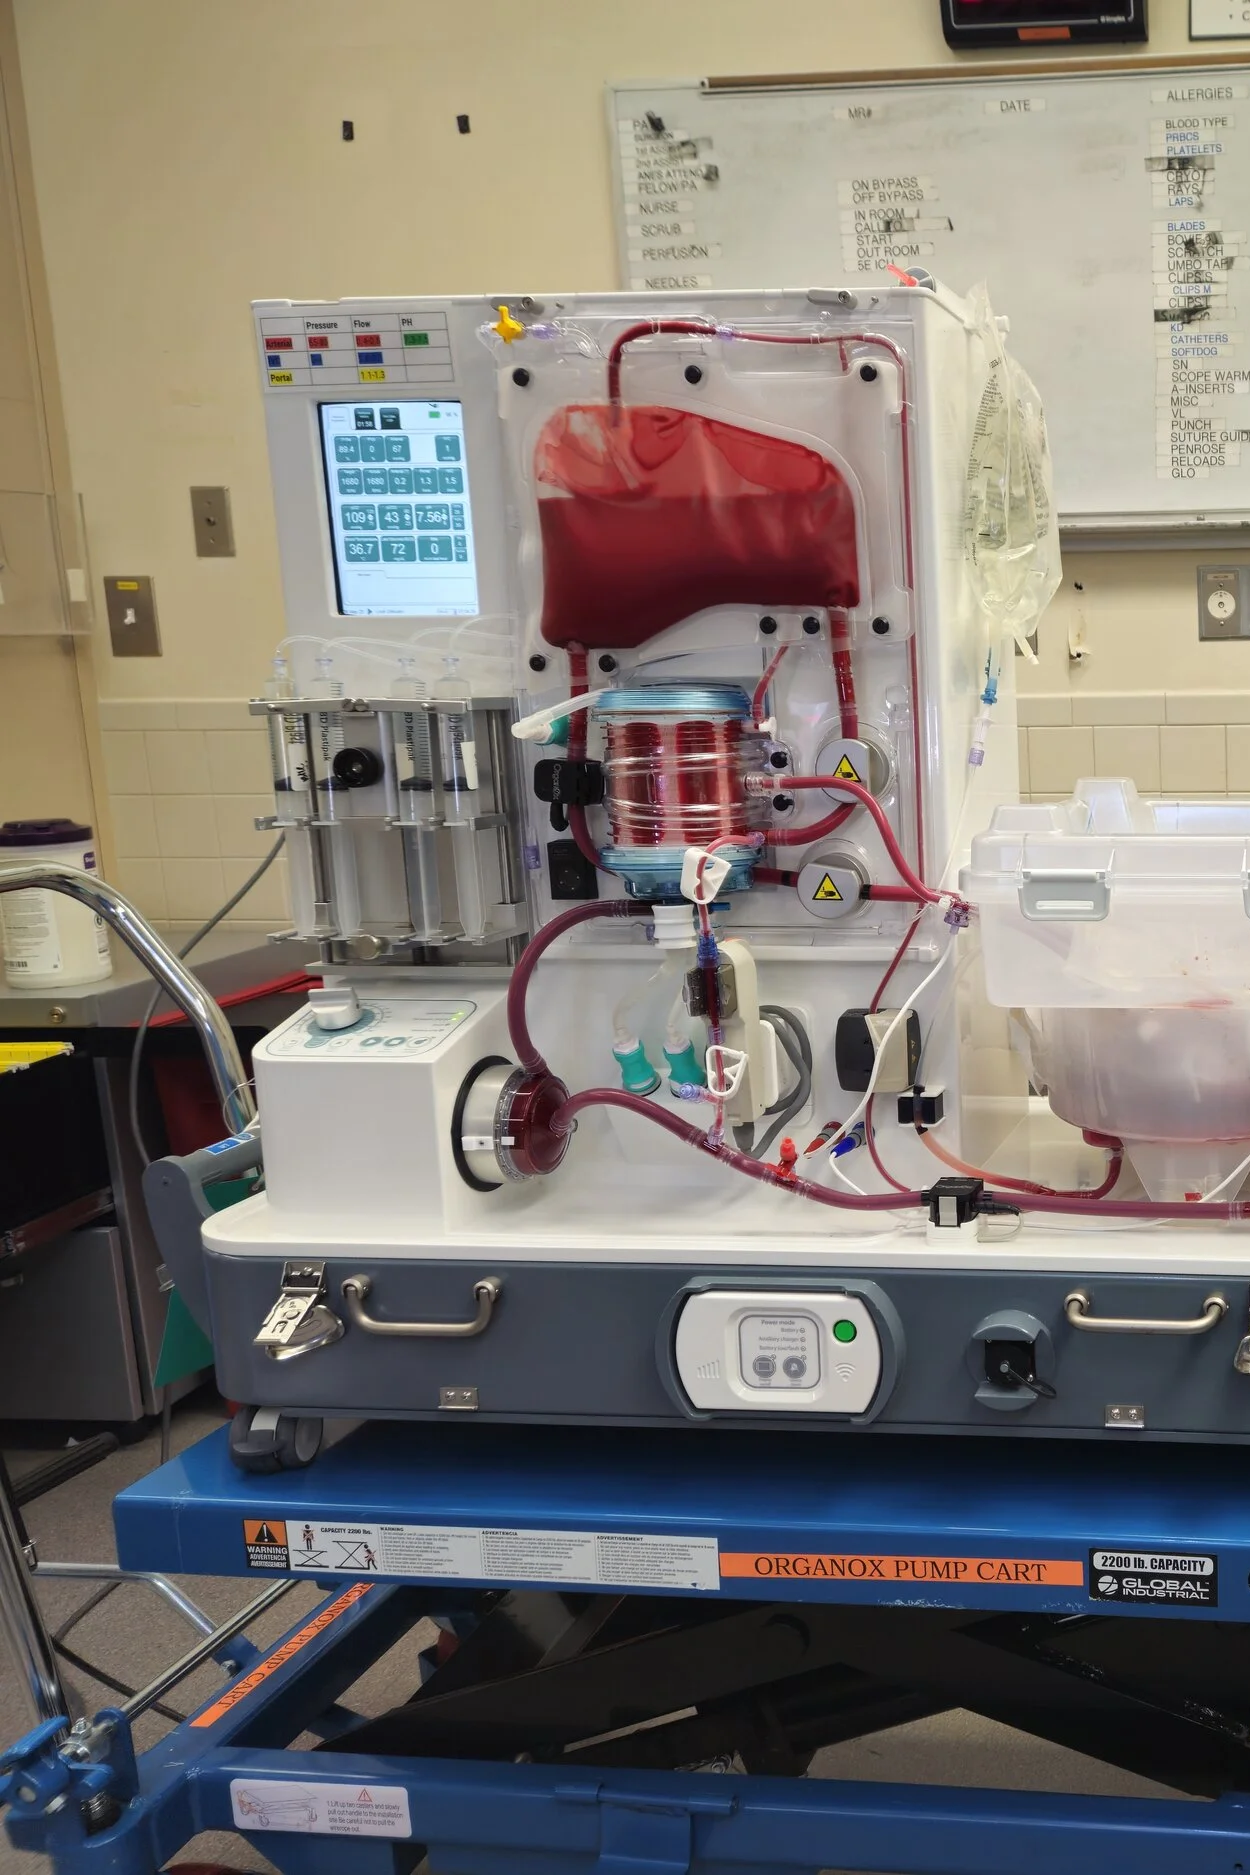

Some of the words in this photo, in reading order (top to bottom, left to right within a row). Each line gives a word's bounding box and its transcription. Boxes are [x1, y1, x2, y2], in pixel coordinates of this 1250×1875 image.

[1167, 86, 1233, 102] ALLERGIES
[1000, 99, 1031, 113] DATE
[1165, 118, 1200, 129] BLOOD
[1203, 116, 1228, 127] TYPE
[1165, 131, 1200, 142] PRBCS
[1166, 143, 1223, 155] PLATELETS
[1166, 170, 1200, 182] CRYO
[681, 180, 697, 191] PA
[852, 179, 869, 191] ON
[872, 177, 918, 190] BYPASS
[1167, 182, 1200, 195] RAYS
[853, 192, 875, 204] OFF
[879, 189, 924, 202] BYPASS
[1168, 196, 1194, 207] LAPS
[639, 200, 679, 215] NURSE
[854, 209, 866, 220] IN
[869, 207, 905, 220] ROOM
[641, 223, 681, 237] SCRUB
[855, 222, 882, 233] CALL
[1167, 221, 1206, 232] BLADES
[856, 234, 893, 246] START
[642, 244, 709, 260] PERFUSION
[857, 246, 880, 259] OUT
[884, 244, 920, 256] ROOM
[1167, 259, 1202, 271] UMBO
[644, 275, 698, 289] NEEDLES
[1168, 271, 1202, 284] CLIPS
[1172, 285, 1201, 295] CLIPS
[1203, 285, 1212, 293] M
[1168, 296, 1202, 308] CLIPS
[306, 321, 338, 330] Pressure
[353, 320, 371, 328] Flow
[401, 318, 413, 326] PH
[1170, 334, 1229, 344] CATHETERS
[1171, 347, 1218, 357] SOFTDOG
[1172, 359, 1188, 370] SN
[270, 373, 293, 382] Portal
[1171, 371, 1211, 382] SCOPE
[1171, 383, 1235, 394] A-INSERTS
[1170, 395, 1199, 407] MISC
[1171, 408, 1185, 418] VL
[1171, 420, 1212, 430] PUNCH
[1170, 432, 1217, 443] SUTURE
[392, 445, 402, 453] 67
[1171, 443, 1226, 455] PENROSE
[1171, 455, 1226, 466] RELOADS
[1171, 467, 1196, 478] GLO
[345, 512, 366, 523] 109
[384, 512, 400, 523] 43
[349, 543, 374, 555] 36.7
[390, 543, 407, 555] 72
[430, 543, 439, 555] 0
[321, 726, 333, 761] Plastipak
[246, 1545, 288, 1555] WARNING
[754, 1556, 886, 1577] ORGANOX
[894, 1560, 968, 1580] PUMP
[976, 1561, 1047, 1582] CART
[1101, 1555, 1131, 1568] 2200
[1133, 1557, 1148, 1569] lb.
[1150, 1557, 1206, 1572] CAPACITY
[1122, 1577, 1209, 1592] GLOBAL
[1122, 1588, 1210, 1600] INDUSTRIAL
[307, 1582, 375, 1631] RGANOX
[265, 1633, 312, 1669] PUMP
[218, 1672, 265, 1708] CART
